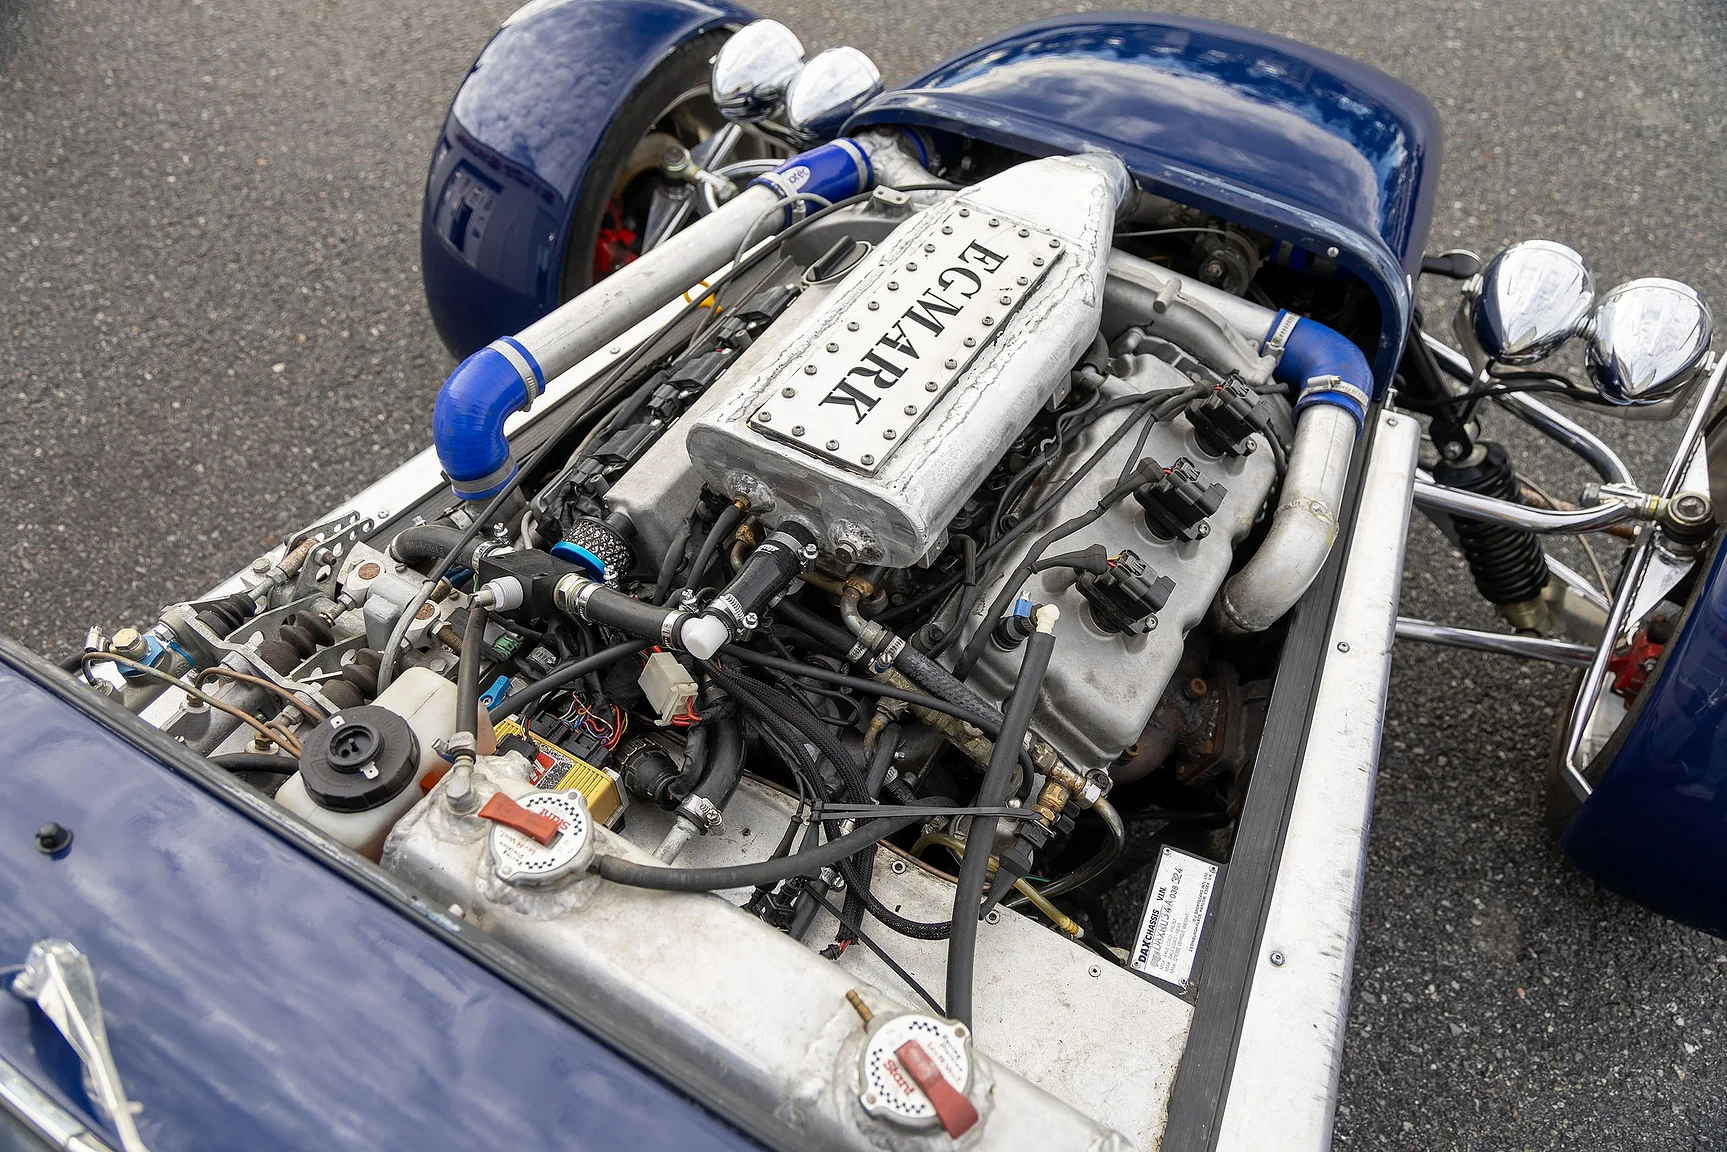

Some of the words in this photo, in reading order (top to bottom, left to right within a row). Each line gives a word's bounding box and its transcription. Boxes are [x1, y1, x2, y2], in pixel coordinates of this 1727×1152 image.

[818, 239, 1009, 425] EGMARK
[1138, 940, 1150, 963] DAX
[1145, 909, 1159, 941] CHASSIS
[883, 1059, 915, 1096] Stant
